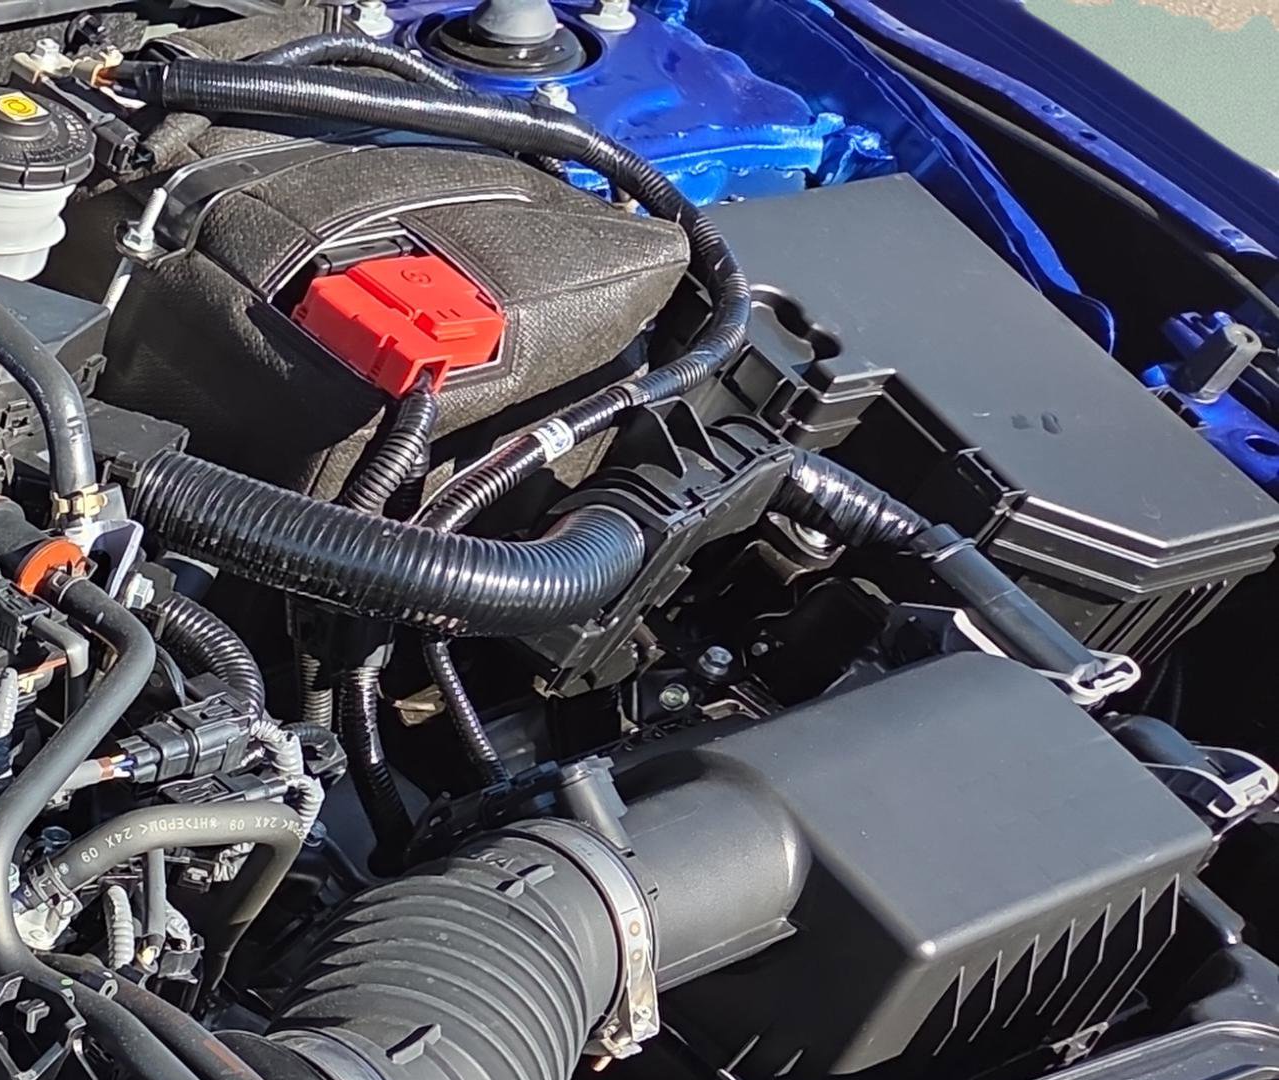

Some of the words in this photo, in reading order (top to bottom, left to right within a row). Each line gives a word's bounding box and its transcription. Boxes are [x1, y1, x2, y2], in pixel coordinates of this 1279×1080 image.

[254, 816, 278, 829] 24X
[103, 827, 134, 849] 24X
[80, 847, 100, 864] 09
